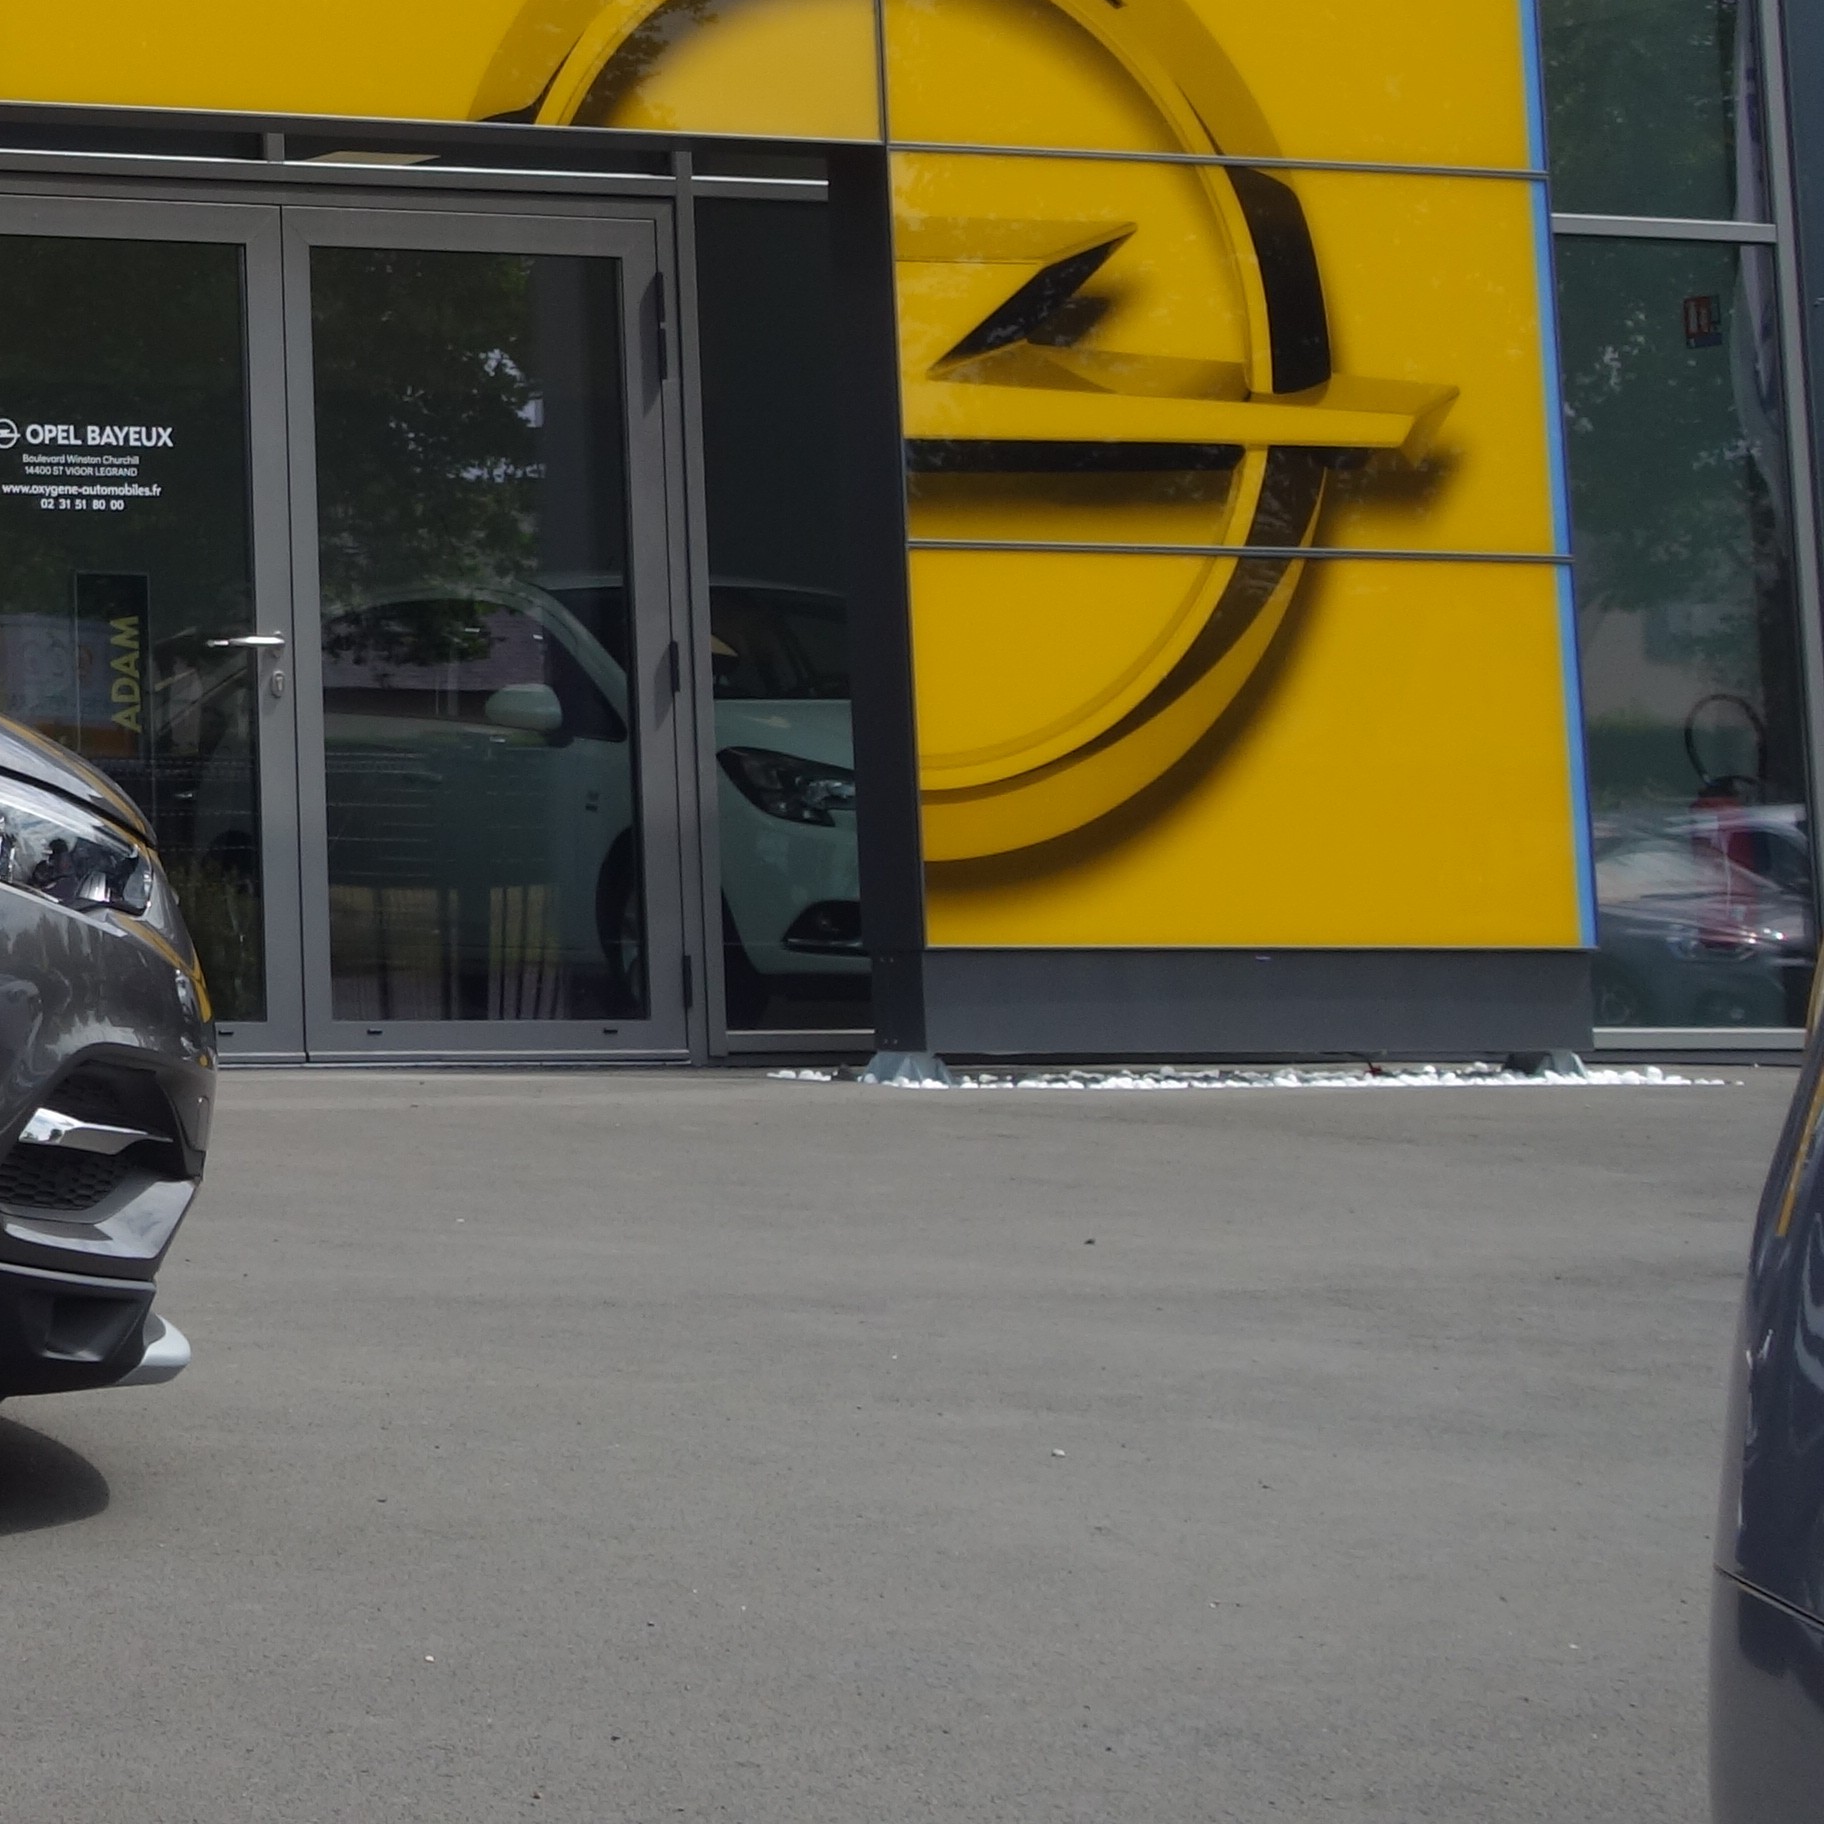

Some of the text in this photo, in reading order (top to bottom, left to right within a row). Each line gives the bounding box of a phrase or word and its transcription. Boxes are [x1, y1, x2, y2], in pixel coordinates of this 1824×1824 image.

[25, 423, 174, 448] OPEL BAYEUX
[22, 453, 140, 465] Boulevard Winston Churchill
[24, 466, 52, 475] 14400
[52, 466, 63, 476] ST
[64, 466, 94, 476] VIGOR
[2, 483, 162, 497] www.oxygene-automobiles.fr
[40, 498, 124, 511] 02 31 51 80 00
[110, 616, 142, 733] ADAM
